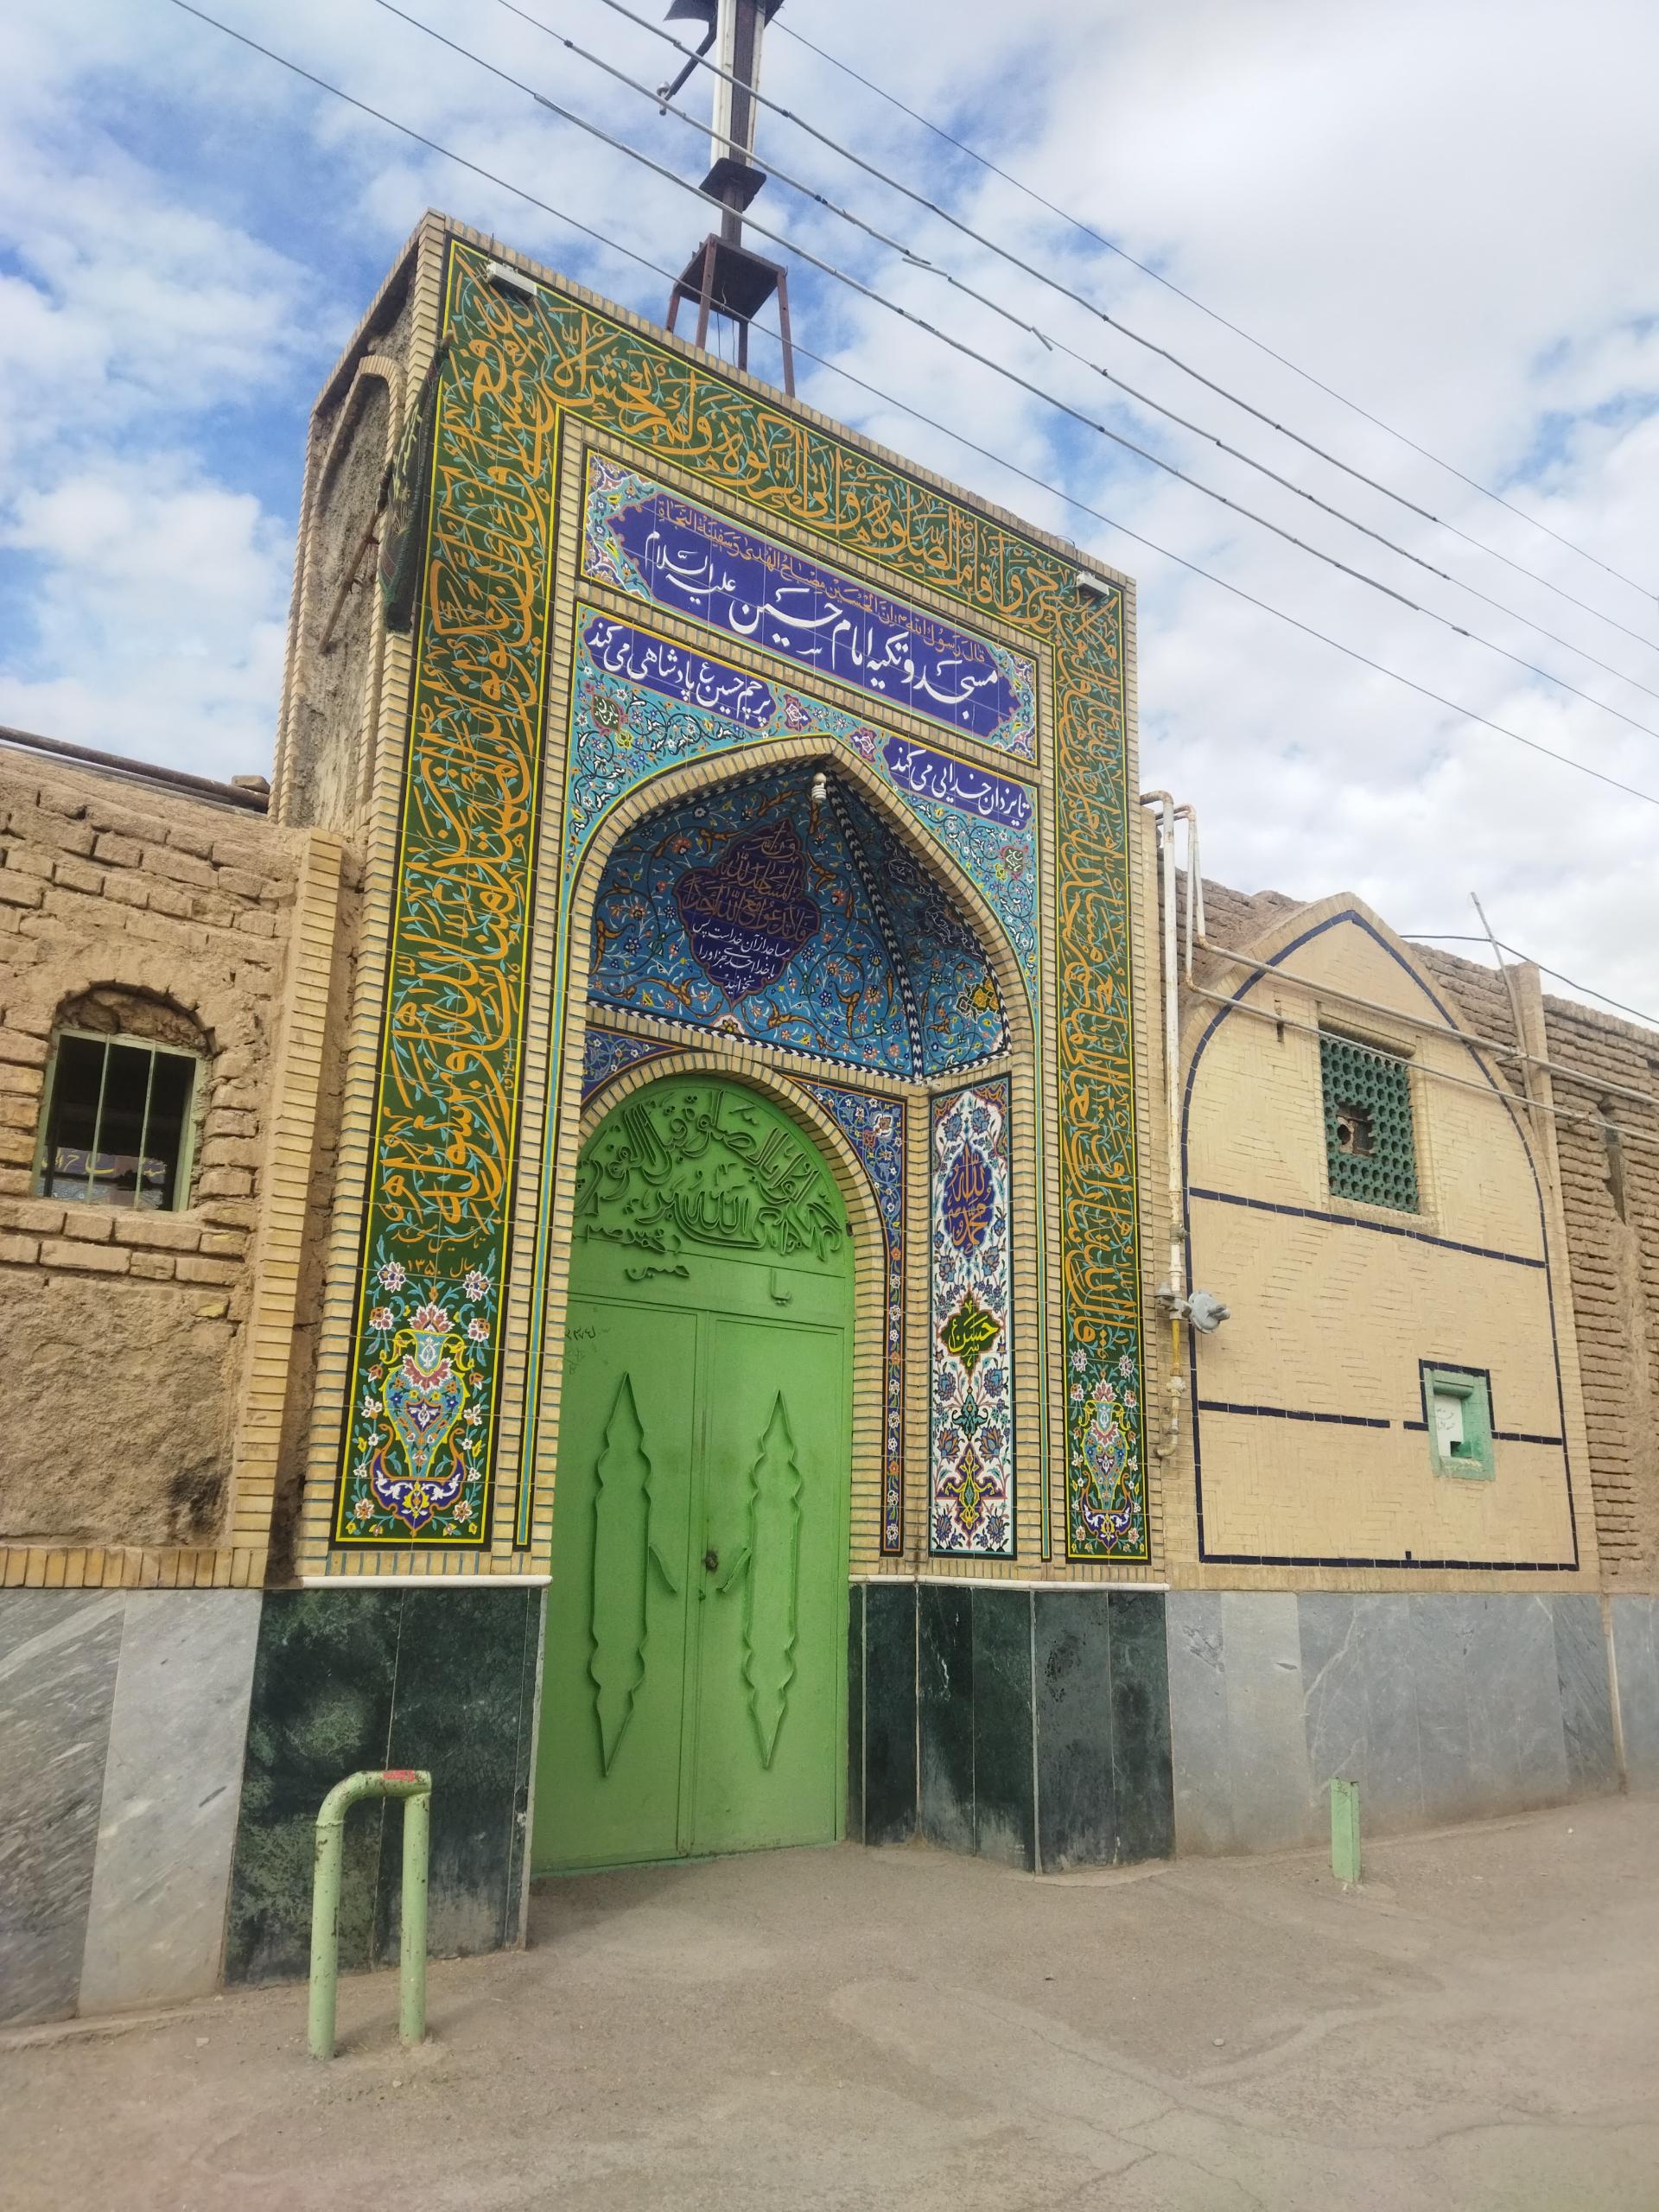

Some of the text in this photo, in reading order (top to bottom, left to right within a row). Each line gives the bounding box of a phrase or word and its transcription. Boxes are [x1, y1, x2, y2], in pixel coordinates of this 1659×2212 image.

[645, 531, 714, 592] السلام
[666, 572, 736, 605] علیه
[588, 622, 624, 647] کند
[832, 620, 874, 670] امام
[604, 643, 630, 671] می
[626, 644, 695, 702] پادشاهی
[901, 652, 915, 683] و
[696, 677, 744, 714] حسین
[736, 680, 772, 728] پرچم
[914, 660, 998, 719] مسجد
[891, 747, 1030, 826] تا یزدان خدایی می کند
[692, 918, 711, 938] پس
[756, 937, 767, 951] از
[761, 942, 791, 961] مساجد
[948, 1141, 987, 1202] الله
[391, 1224, 438, 1249] مسجد
[952, 1202, 988, 1247] محمد
[449, 1258, 475, 1278] سال
[949, 1313, 999, 1351] حسن
